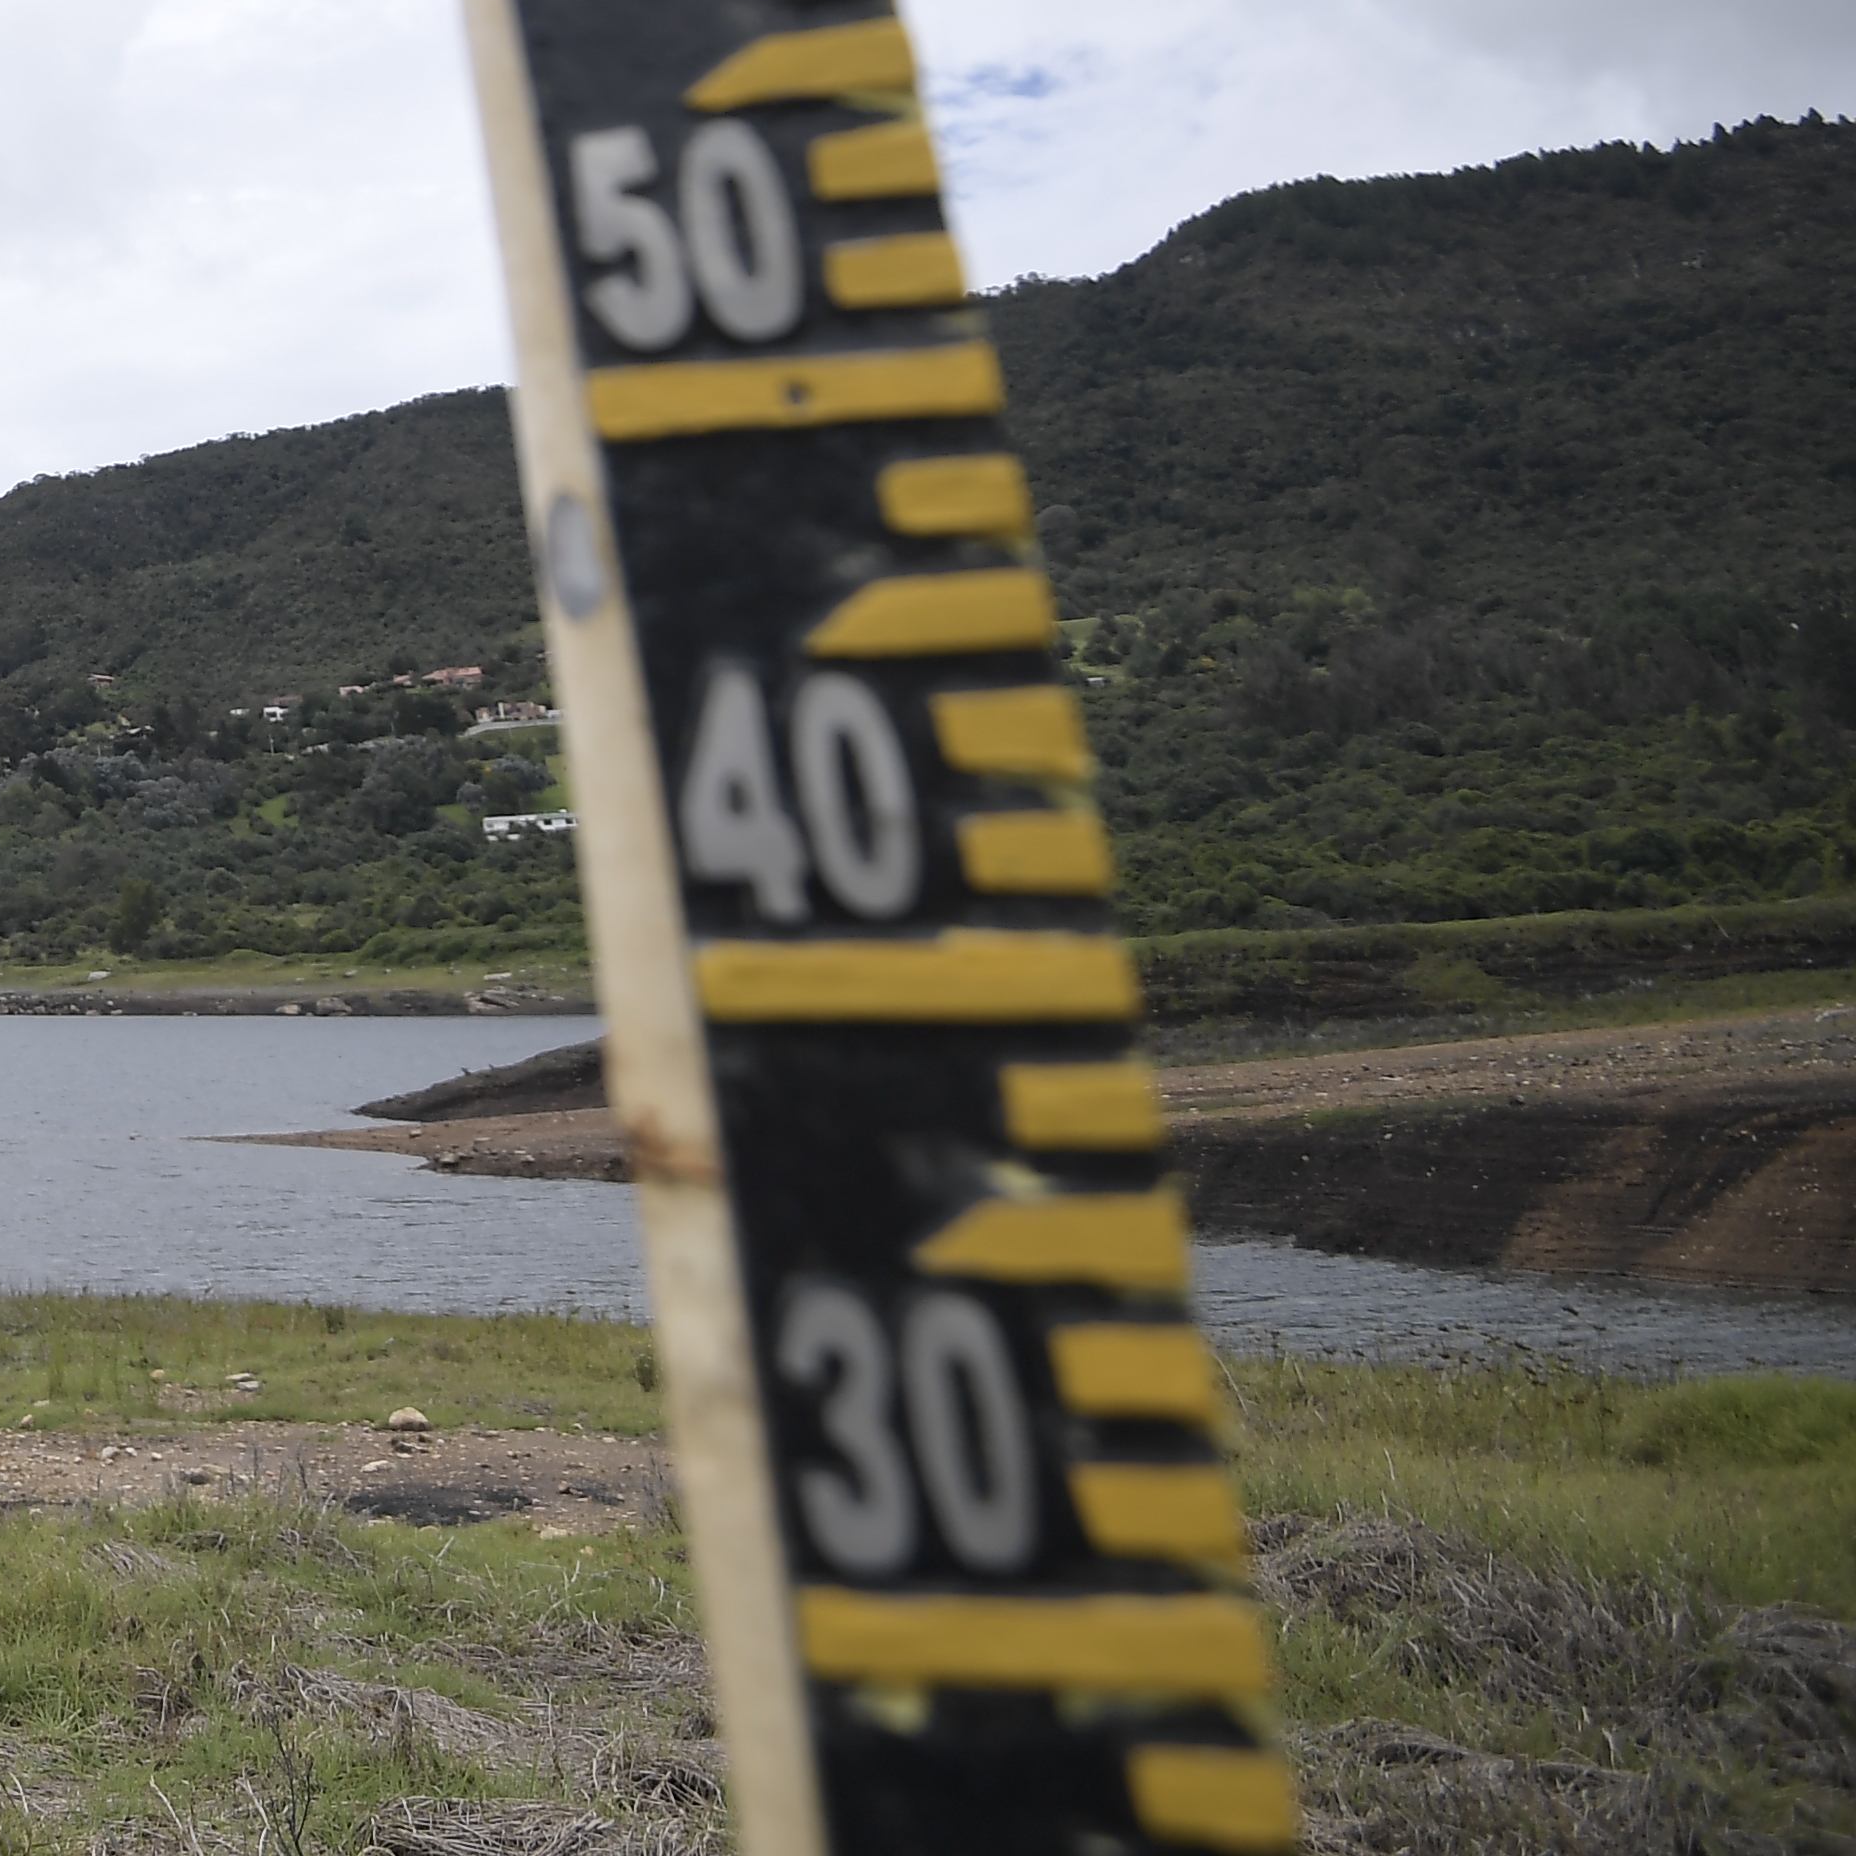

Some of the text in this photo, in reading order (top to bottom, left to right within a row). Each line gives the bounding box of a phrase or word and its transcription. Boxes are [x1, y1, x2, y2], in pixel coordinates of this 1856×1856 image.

[570, 118, 805, 349] 50
[682, 662, 922, 922] 40
[778, 1289, 1036, 1574] 30
